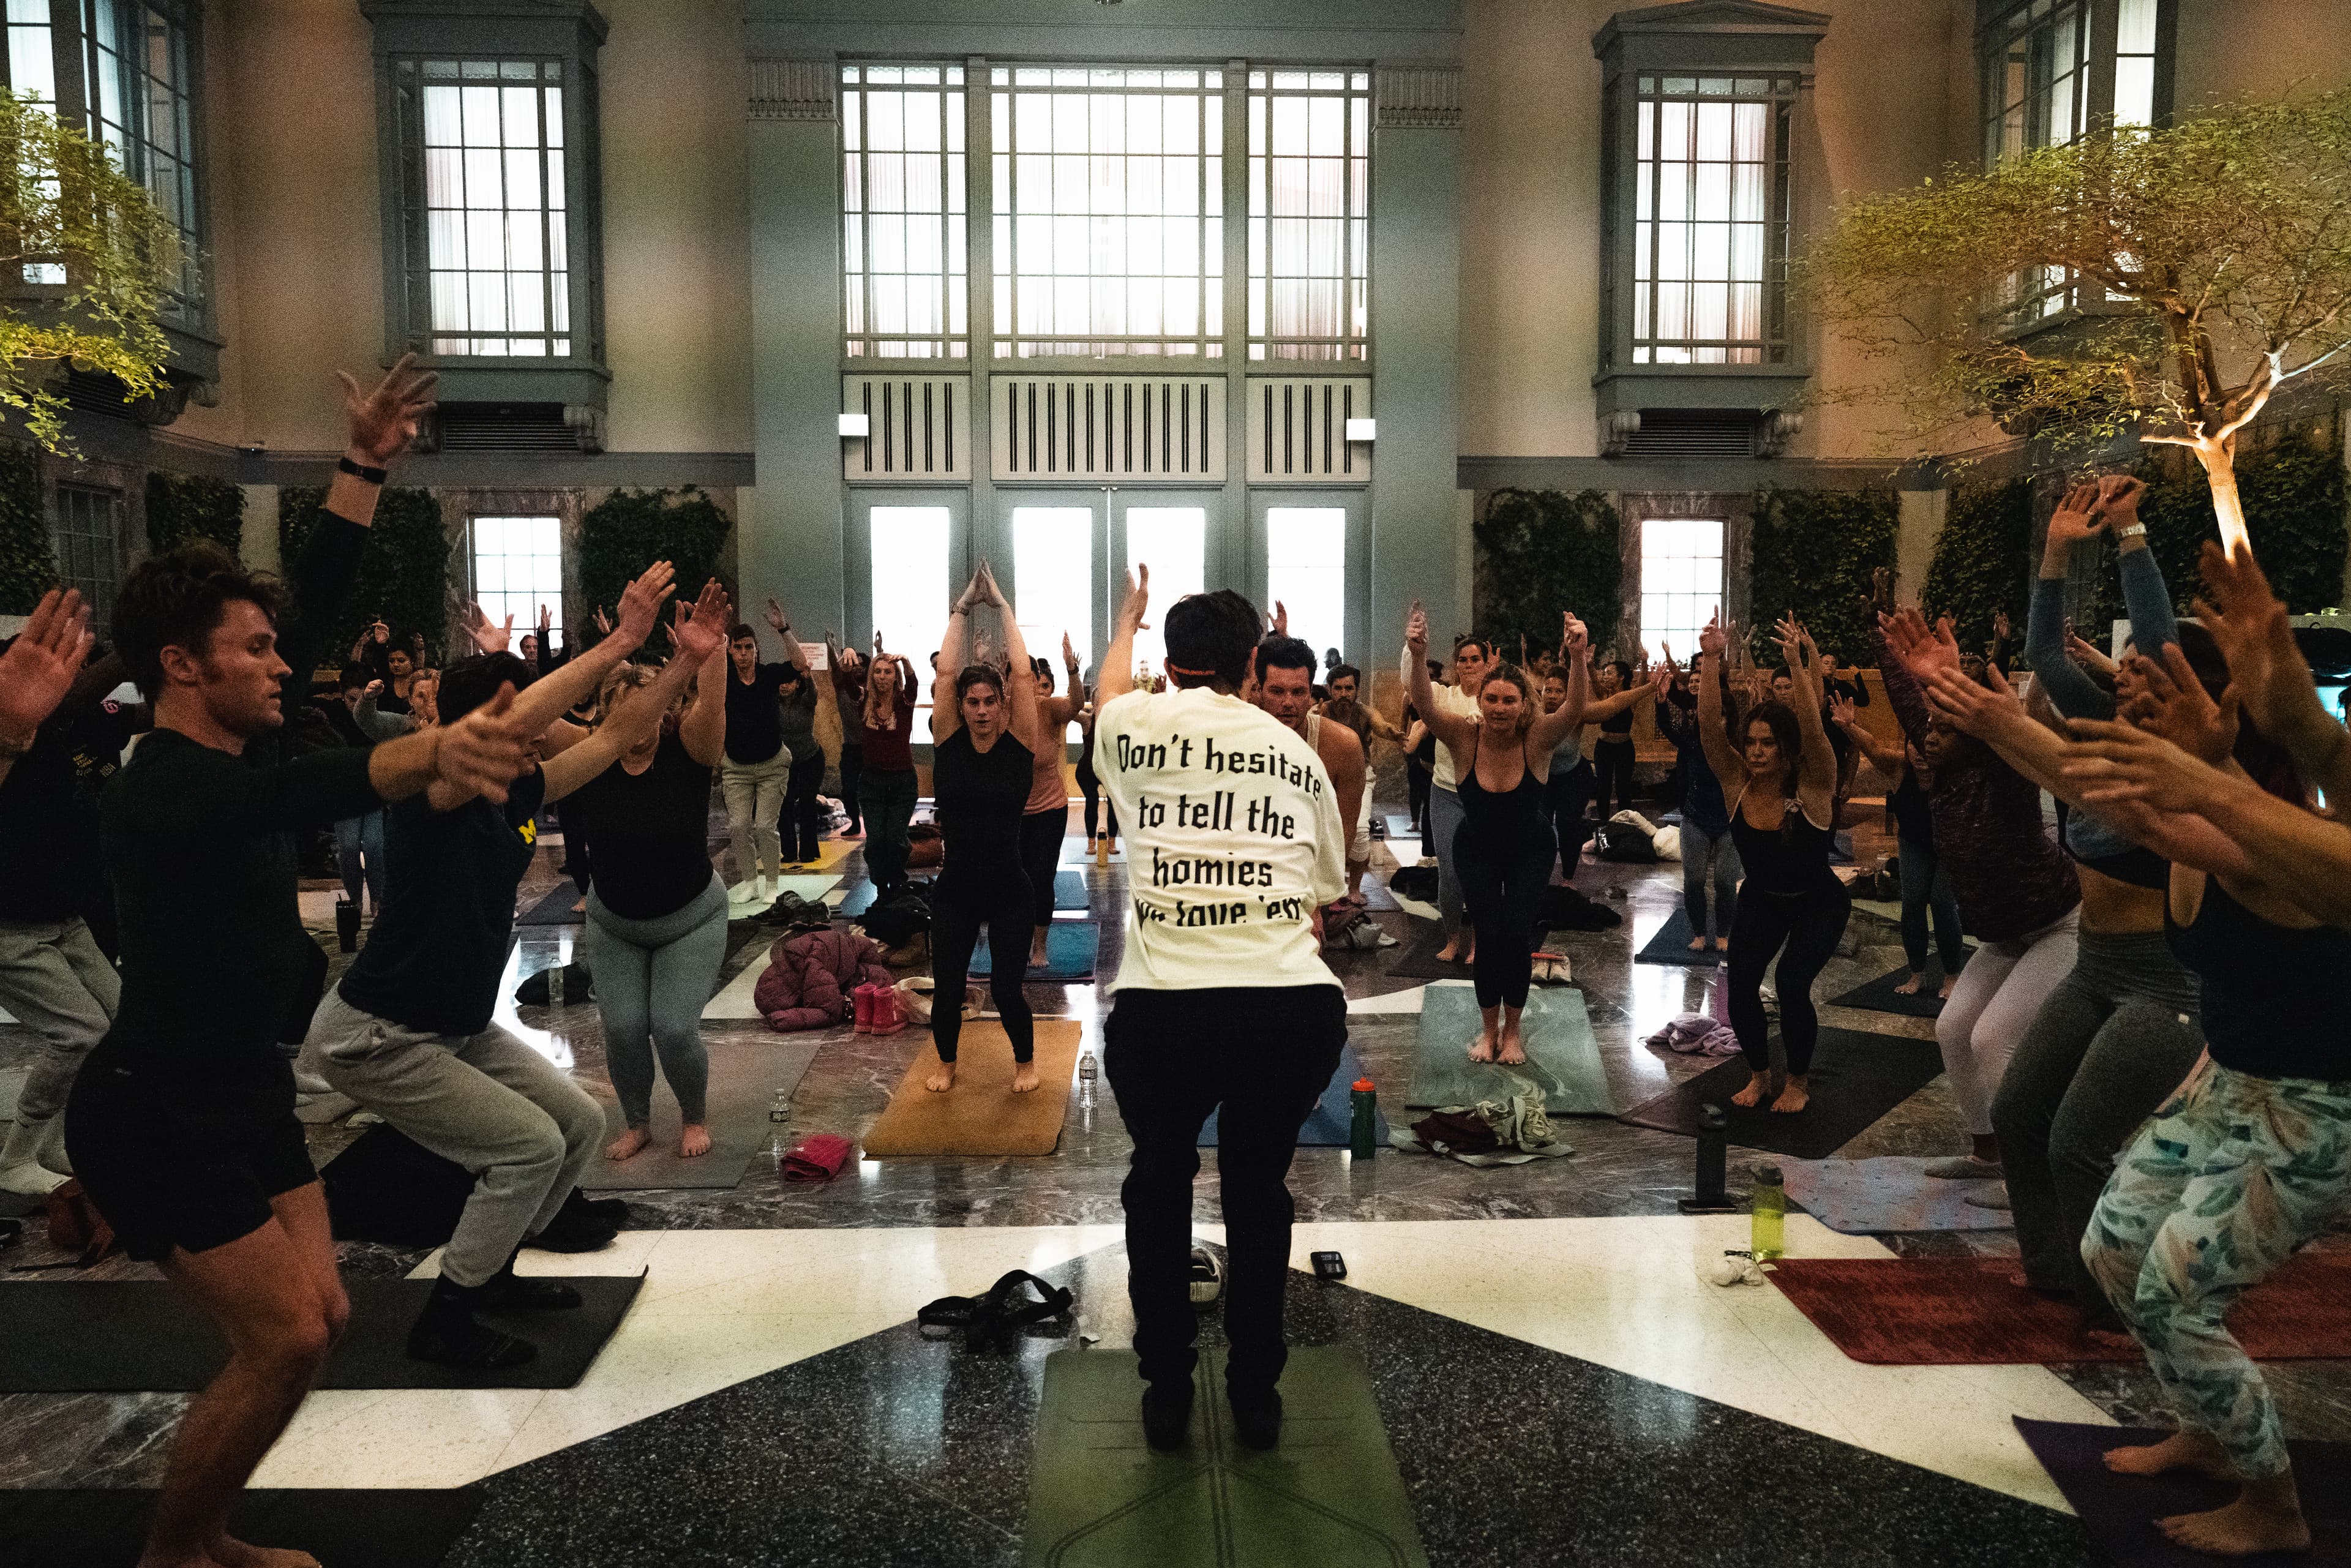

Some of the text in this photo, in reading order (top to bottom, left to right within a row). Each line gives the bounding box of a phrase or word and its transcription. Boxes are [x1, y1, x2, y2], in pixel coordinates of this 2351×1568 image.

[1117, 734, 1321, 801] Don't hesitate
[1139, 791, 1295, 839] to tell the
[1153, 847, 1273, 887] homies
